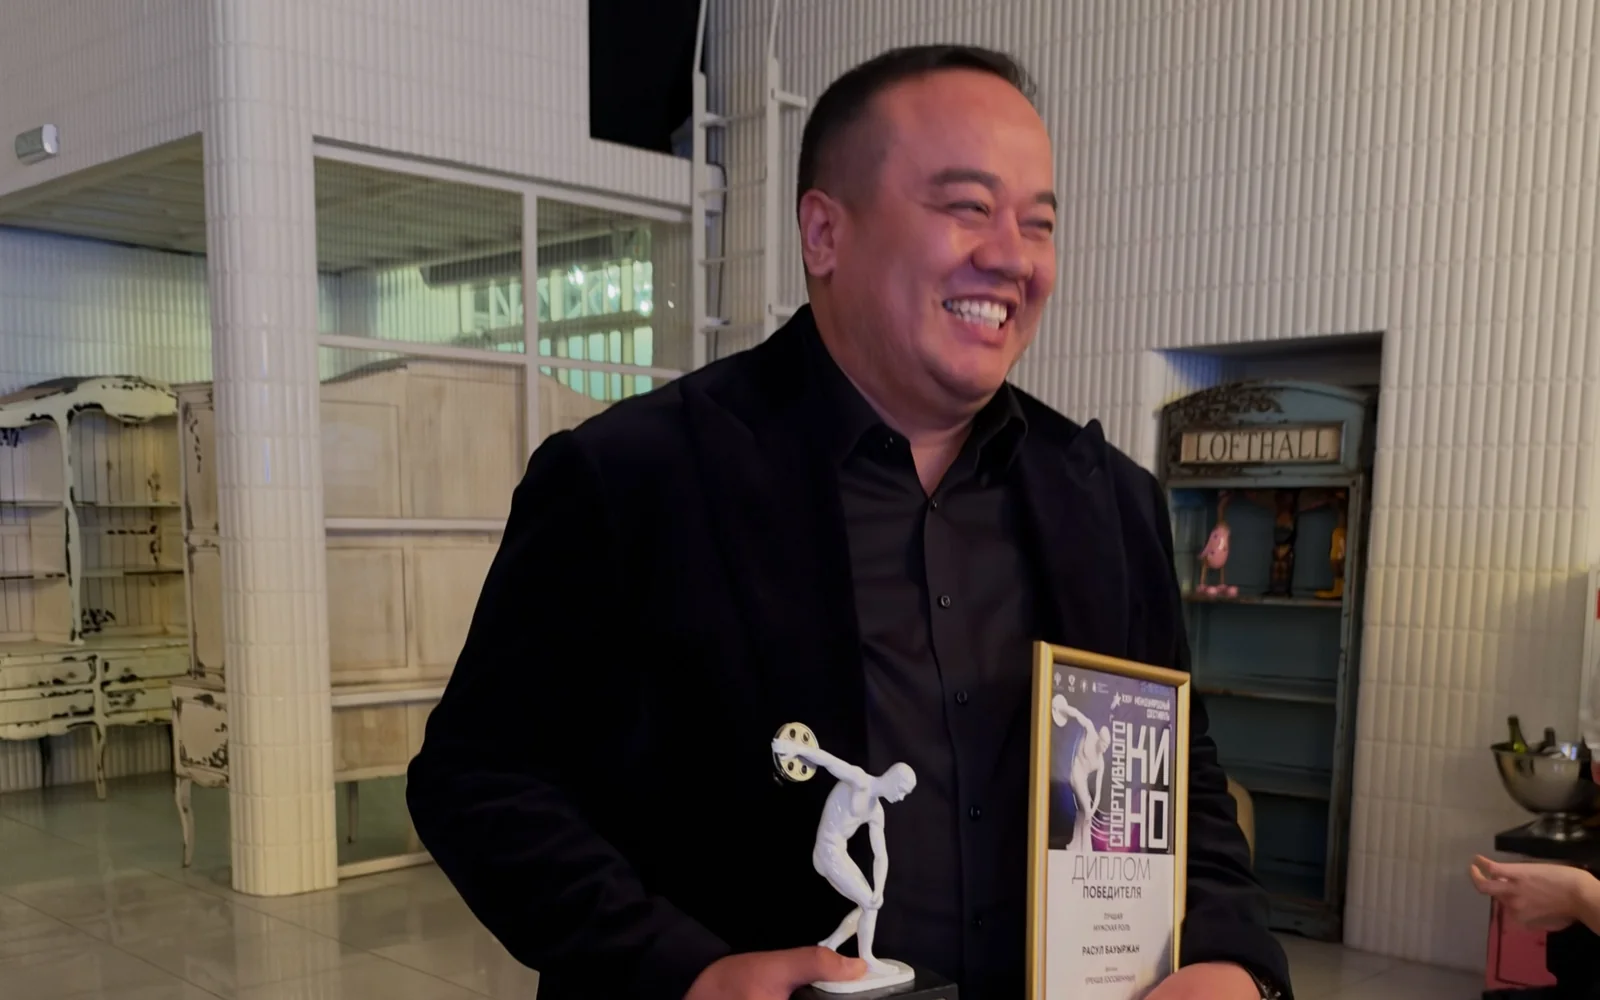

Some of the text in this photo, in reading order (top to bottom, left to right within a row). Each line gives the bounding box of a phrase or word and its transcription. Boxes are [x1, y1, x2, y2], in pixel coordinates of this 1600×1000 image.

[1196, 429, 1328, 462] LOFTHALL
[1109, 720, 1126, 848] СПОРТИВНОГО
[1071, 854, 1151, 884] ДИПЛОМ
[1082, 885, 1142, 900] ПОБЕДИТЕЛЯ
[1081, 943, 1140, 956] РАСУЛ БАУЫРЖАН
